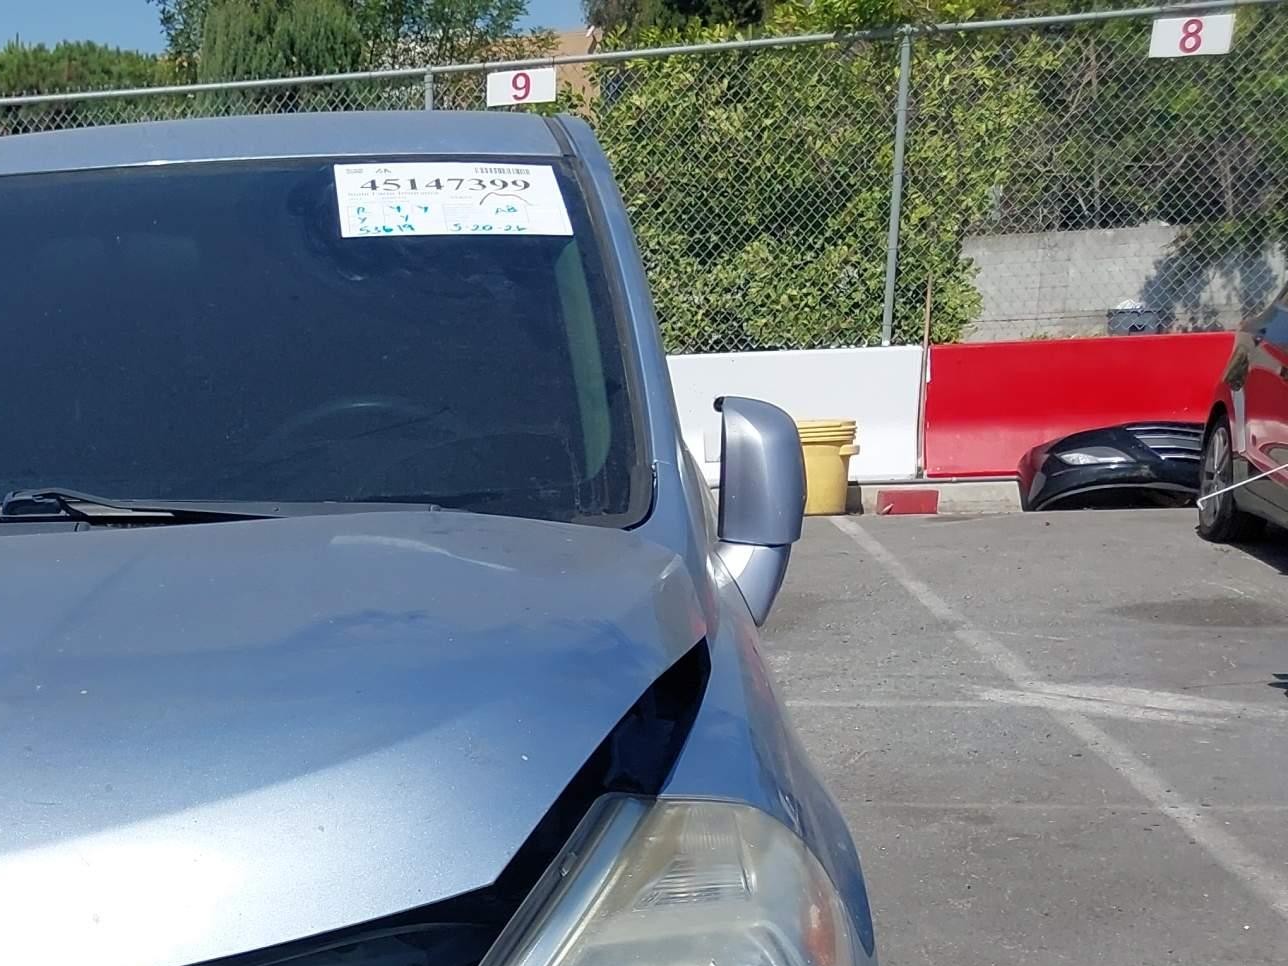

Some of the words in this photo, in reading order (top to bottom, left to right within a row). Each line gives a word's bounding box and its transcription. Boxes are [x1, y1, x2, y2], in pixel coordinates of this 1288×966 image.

[1179, 18, 1203, 54] 8
[512, 72, 531, 101] 9
[360, 178, 530, 192] 45147399
